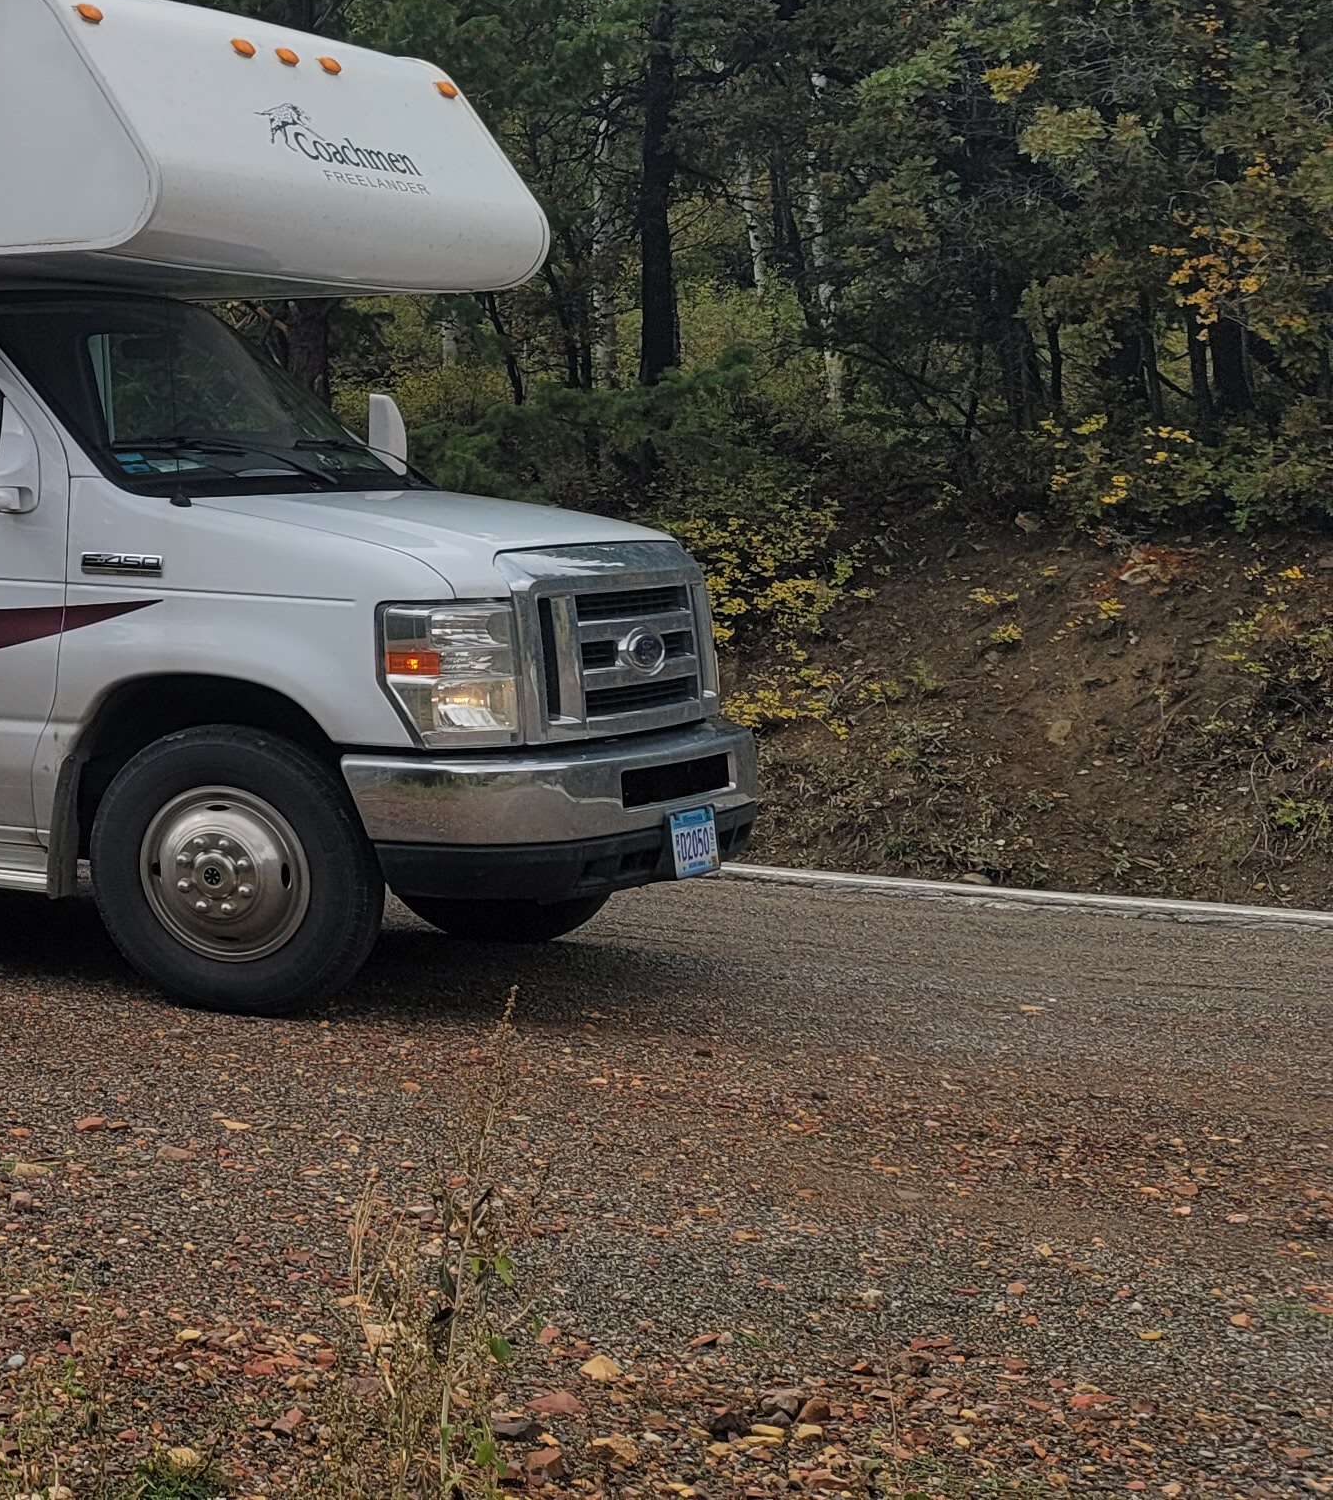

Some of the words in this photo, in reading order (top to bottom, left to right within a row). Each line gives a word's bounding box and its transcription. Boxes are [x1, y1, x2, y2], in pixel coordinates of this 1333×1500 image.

[293, 131, 423, 177] Coachmen
[322, 169, 431, 196] FREELANDER
[81, 553, 162, 570] E-450
[680, 826, 710, 862] D2050
